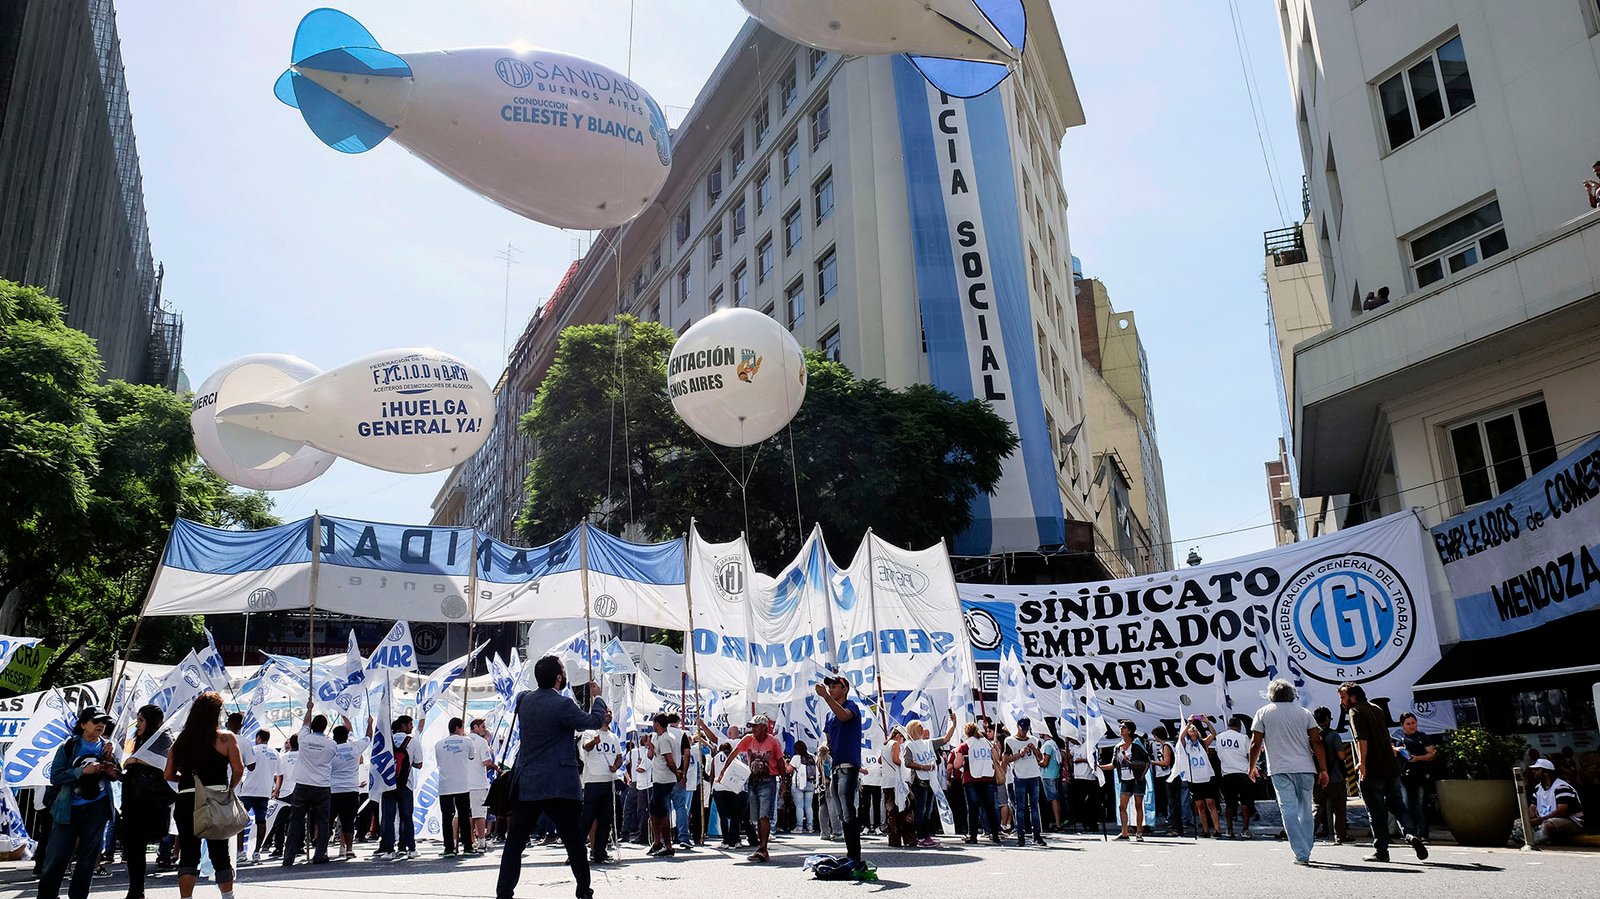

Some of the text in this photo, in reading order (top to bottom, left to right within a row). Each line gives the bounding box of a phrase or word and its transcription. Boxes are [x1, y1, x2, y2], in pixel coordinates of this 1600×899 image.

[513, 96, 568, 110] CONDUCCION
[533, 61, 639, 101] SANIDAD
[538, 83, 643, 116] BUENOS AIRES
[501, 104, 644, 146] CELESTE Y BLANCA
[957, 220, 1006, 401] SOCIAL
[690, 374, 724, 393] AIRES
[358, 417, 482, 437] GENERAL YA!
[382, 399, 468, 417] ¡HUELGA
[1433, 502, 1520, 566] EMPLEADOS
[1526, 505, 1545, 532] de
[1019, 566, 1281, 625] SINDICATO
[1317, 559, 1373, 574] GENERAL
[1375, 568, 1396, 590] DEL
[1392, 589, 1408, 647] TRABAJO
[1491, 545, 1600, 622] MENDOZA
[1020, 604, 1272, 658] EMPLEADOS
[1298, 574, 1388, 662] CGT
[1028, 645, 1278, 691] COMERCIO
[1221, 738, 1240, 749] UDA
